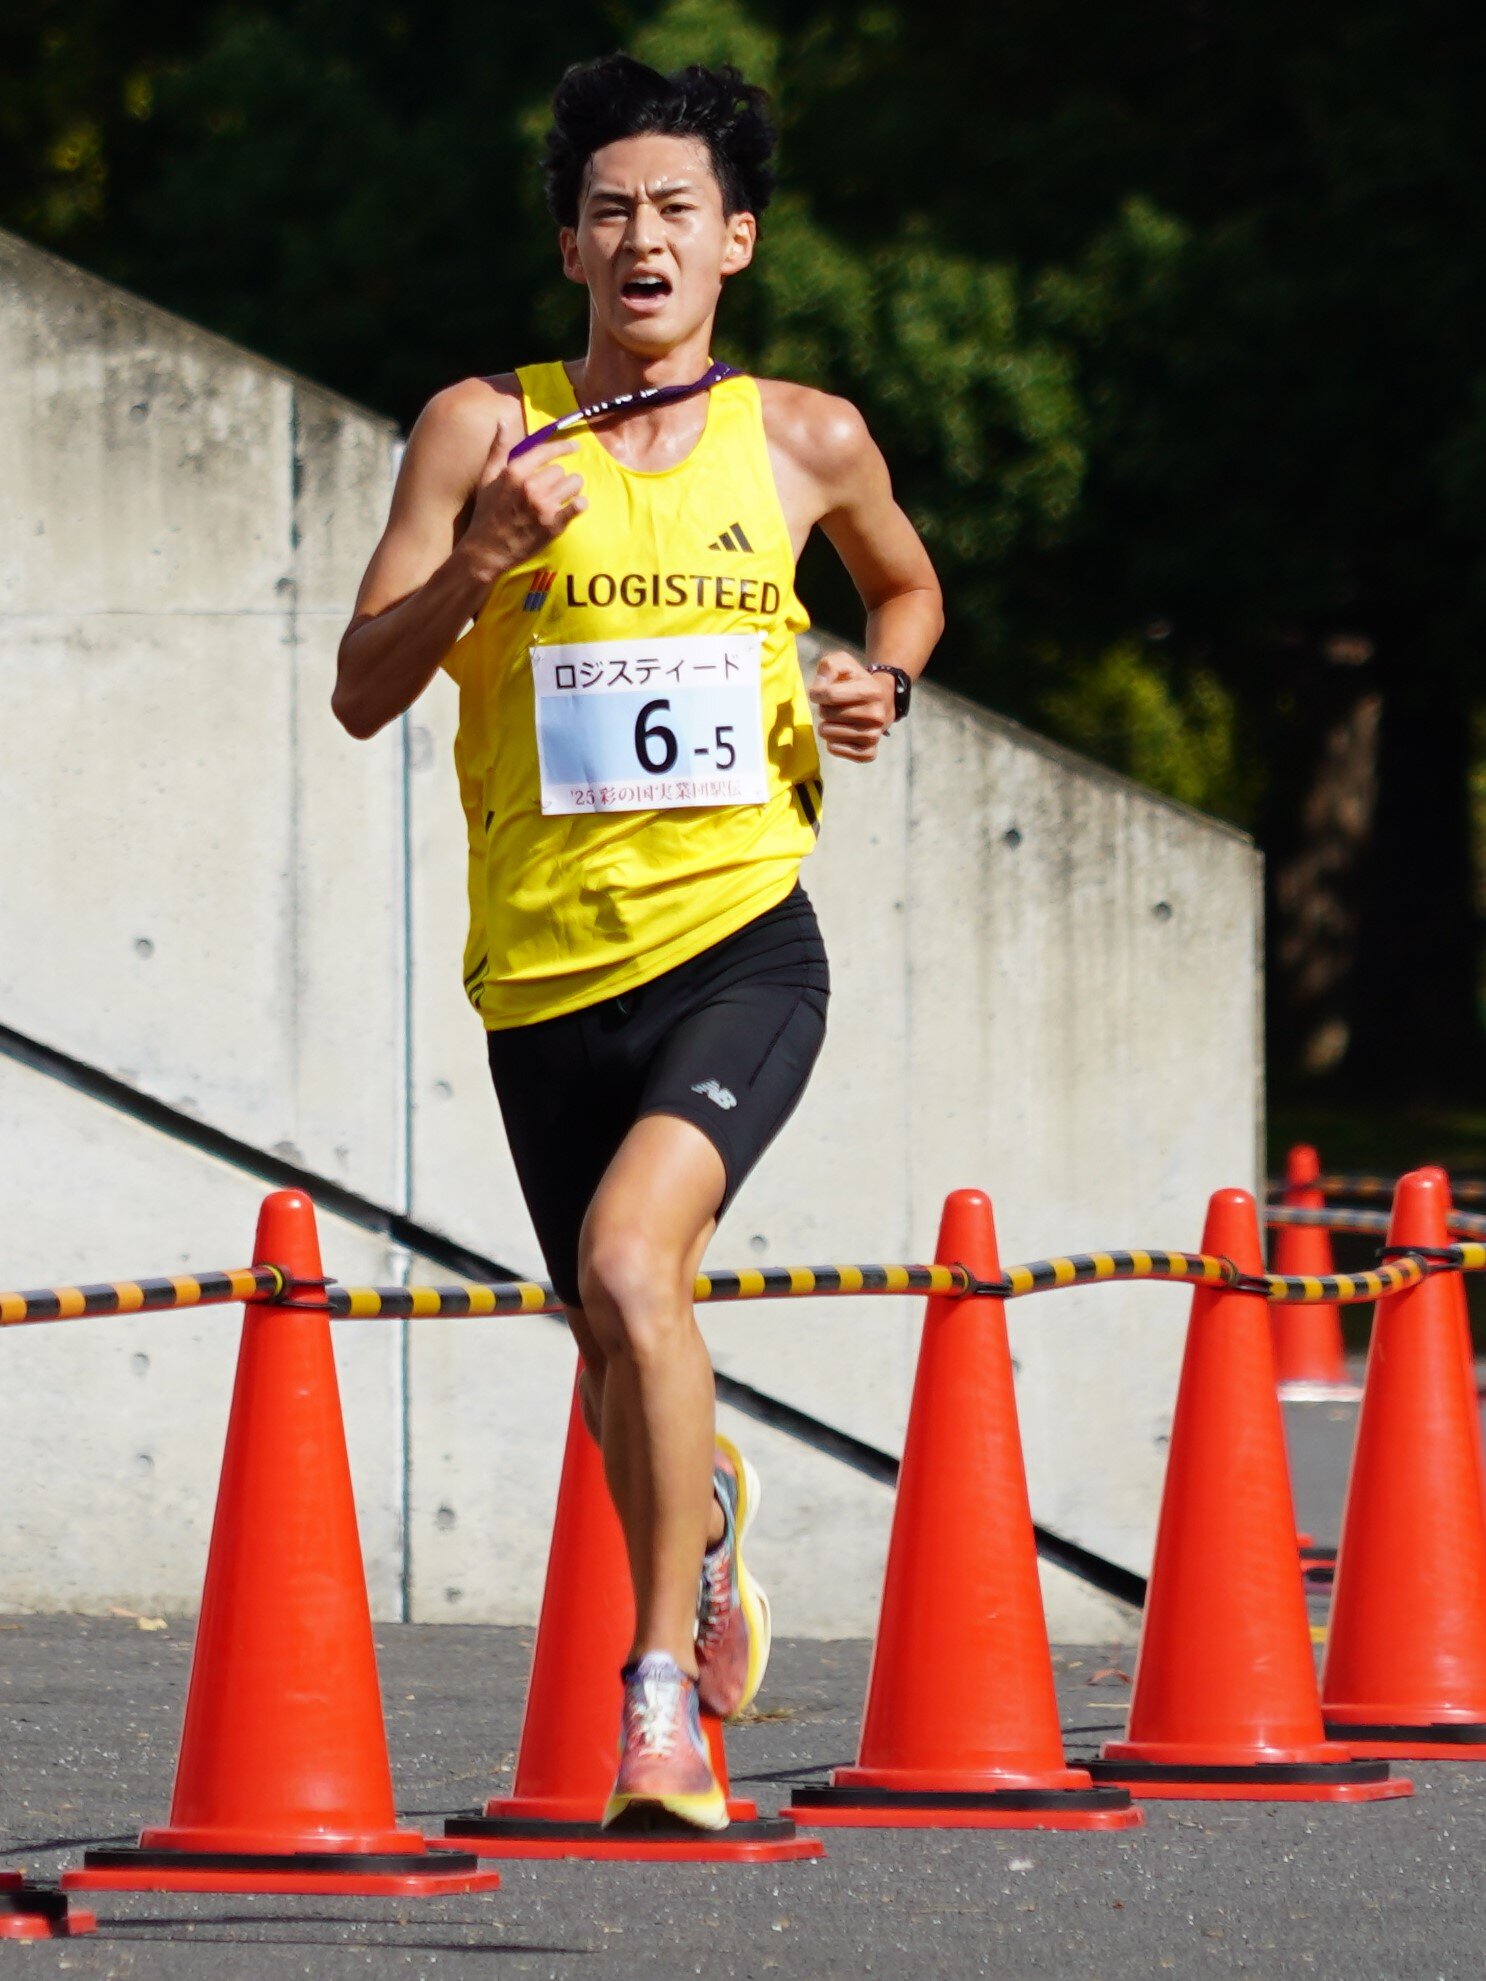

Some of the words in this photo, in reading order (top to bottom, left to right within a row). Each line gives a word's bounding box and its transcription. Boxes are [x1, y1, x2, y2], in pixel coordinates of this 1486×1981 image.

[566, 573, 781, 615] LOGISTEED
[555, 653, 739, 689] ロジスティード
